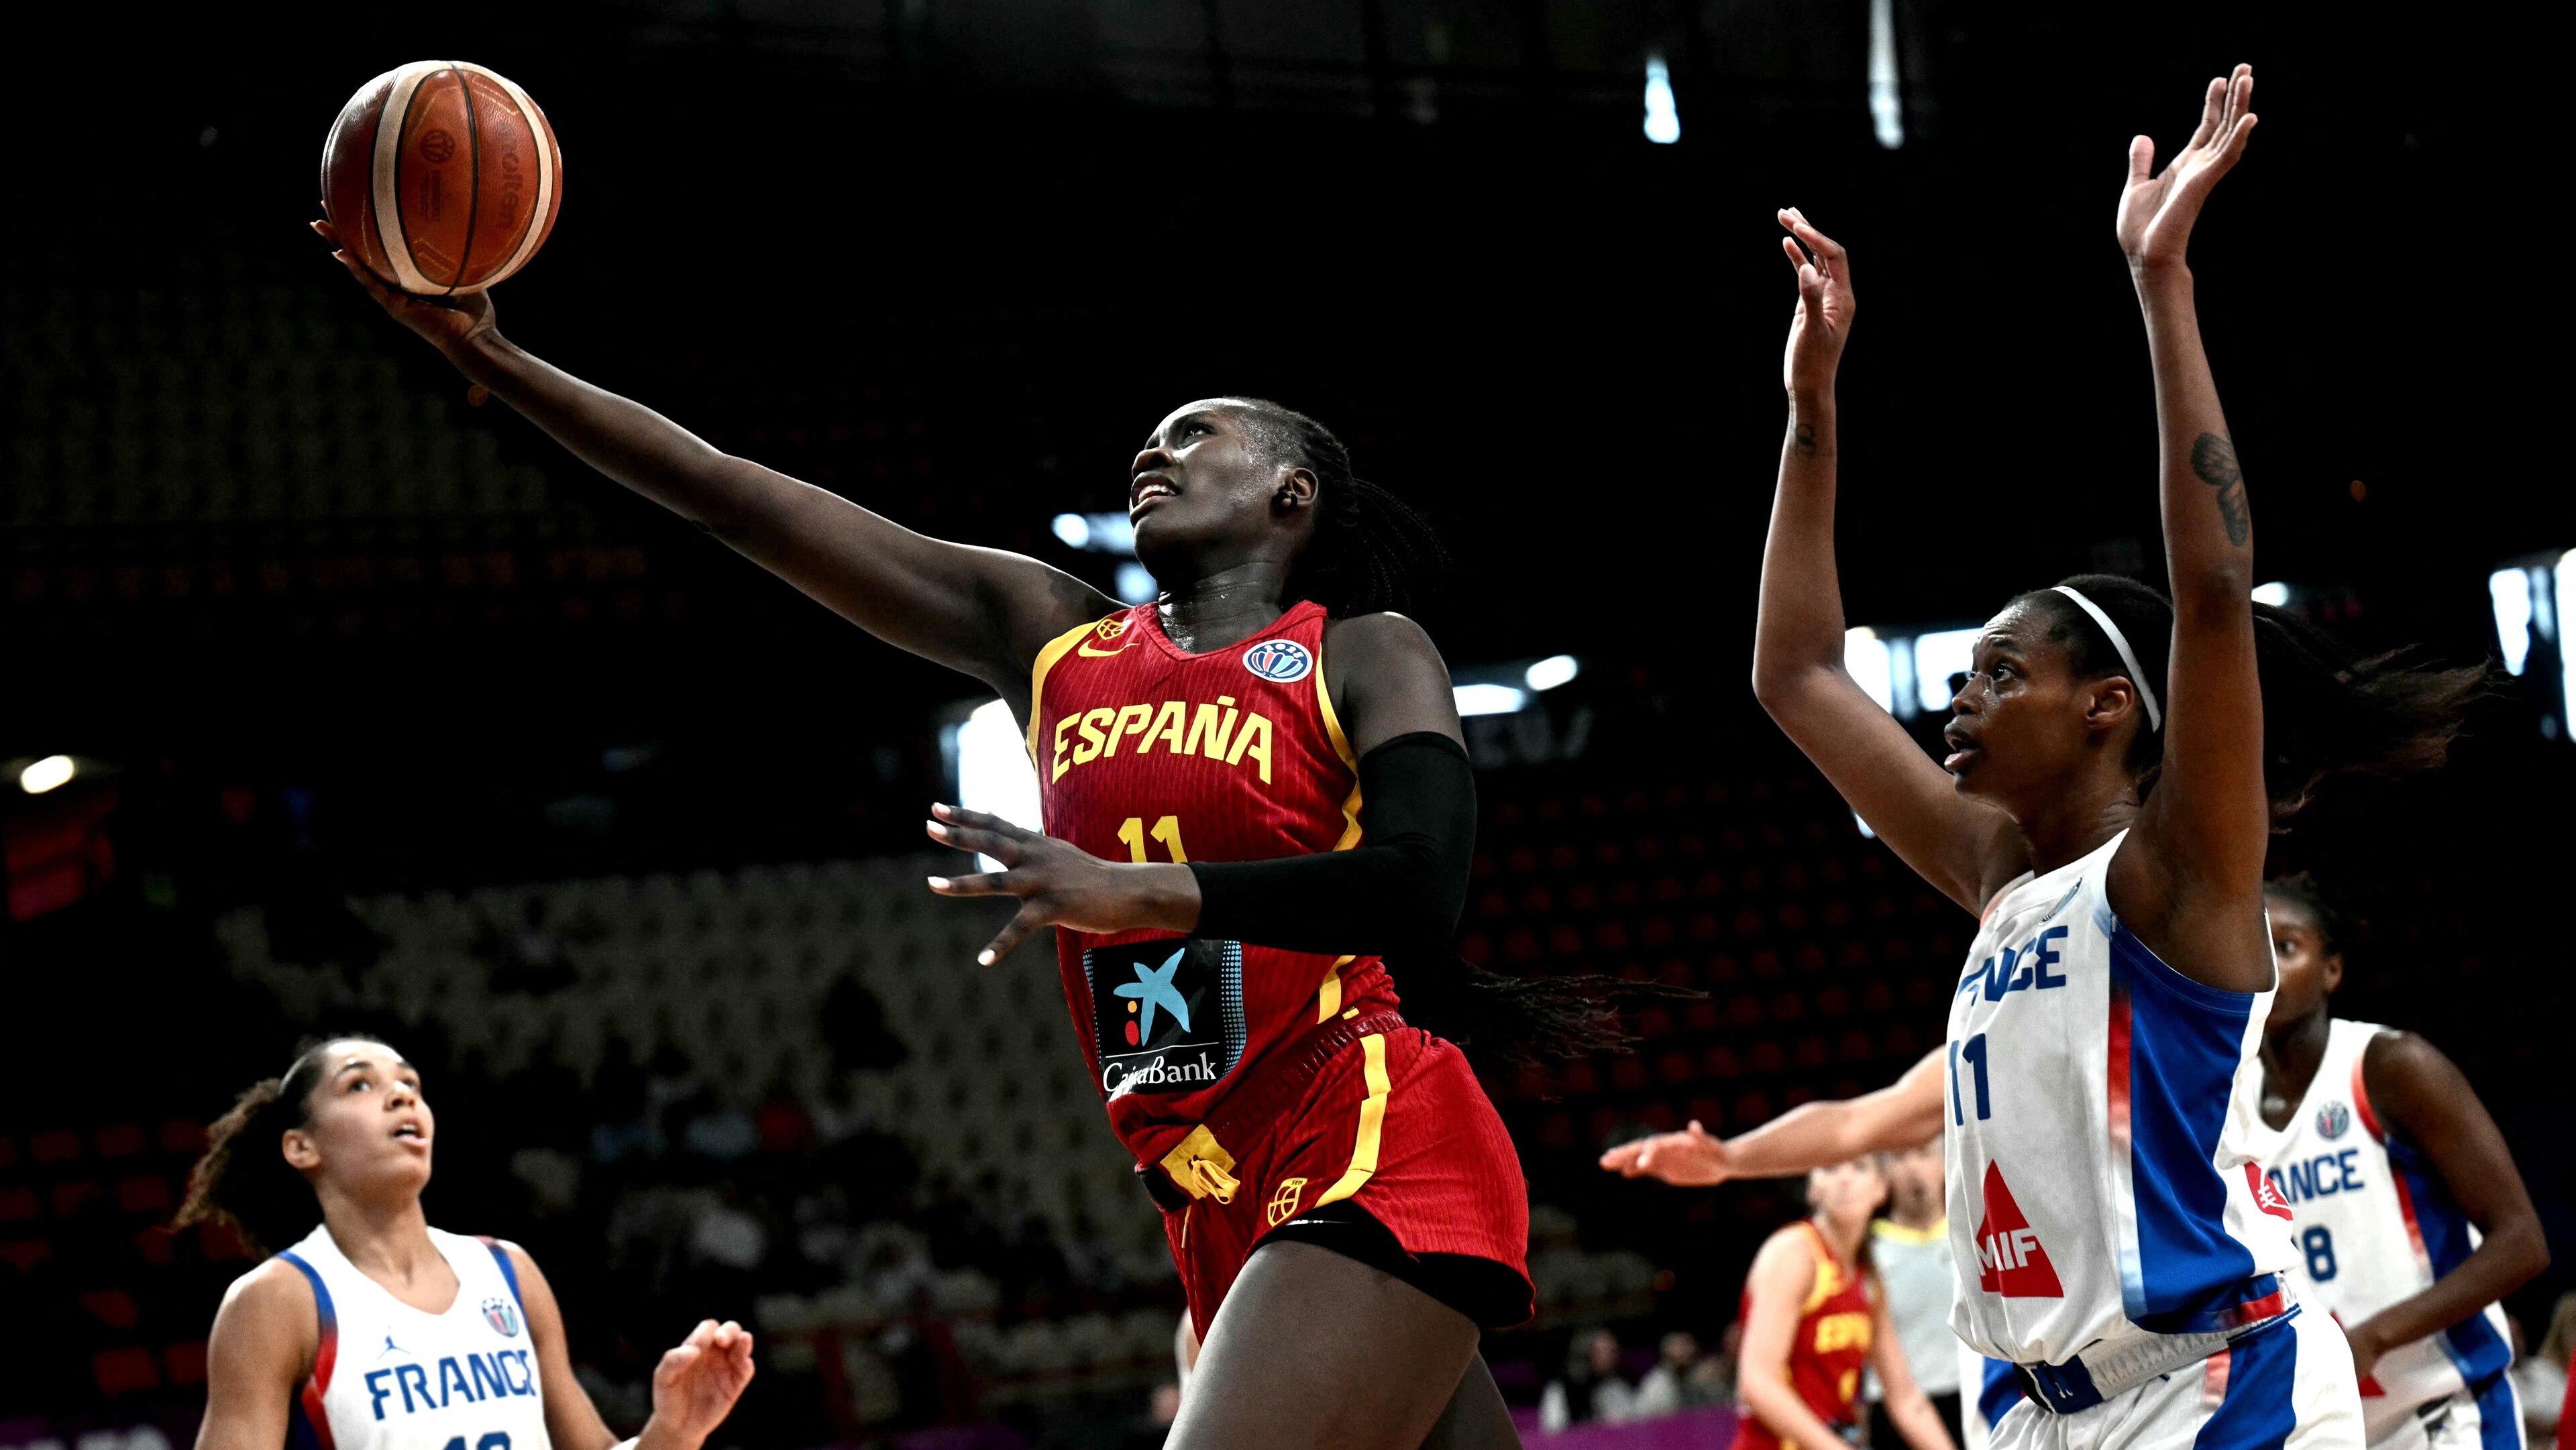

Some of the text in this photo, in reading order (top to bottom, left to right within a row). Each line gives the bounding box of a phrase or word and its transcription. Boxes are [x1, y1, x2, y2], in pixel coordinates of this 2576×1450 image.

[1052, 695, 1272, 785] ESPAÑA
[1117, 816, 1188, 864] 11
[1975, 1227, 2037, 1276] MIF
[2292, 1224, 2338, 1282] 8
